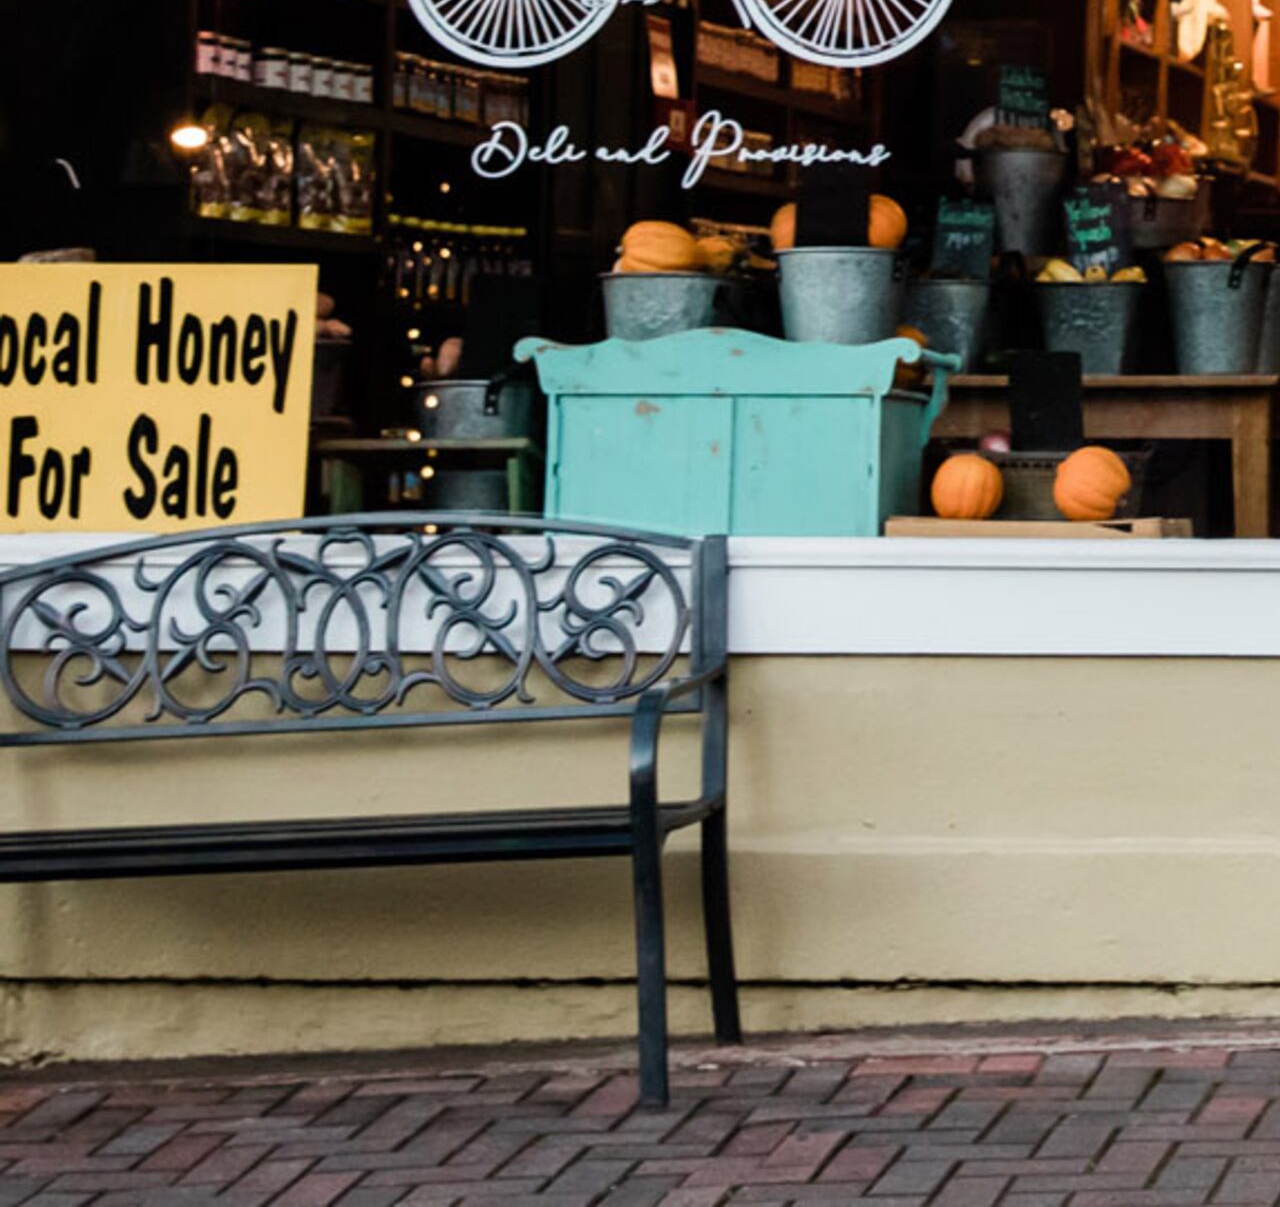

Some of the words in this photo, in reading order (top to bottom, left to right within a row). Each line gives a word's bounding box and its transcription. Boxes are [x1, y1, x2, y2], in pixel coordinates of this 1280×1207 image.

[471, 121, 587, 178] Deli
[595, 125, 671, 165] and
[681, 109, 891, 189] Provisions
[0, 280, 102, 387] ocal
[136, 277, 298, 414] Honey
[6, 415, 91, 520] For
[122, 413, 238, 520] Sale
